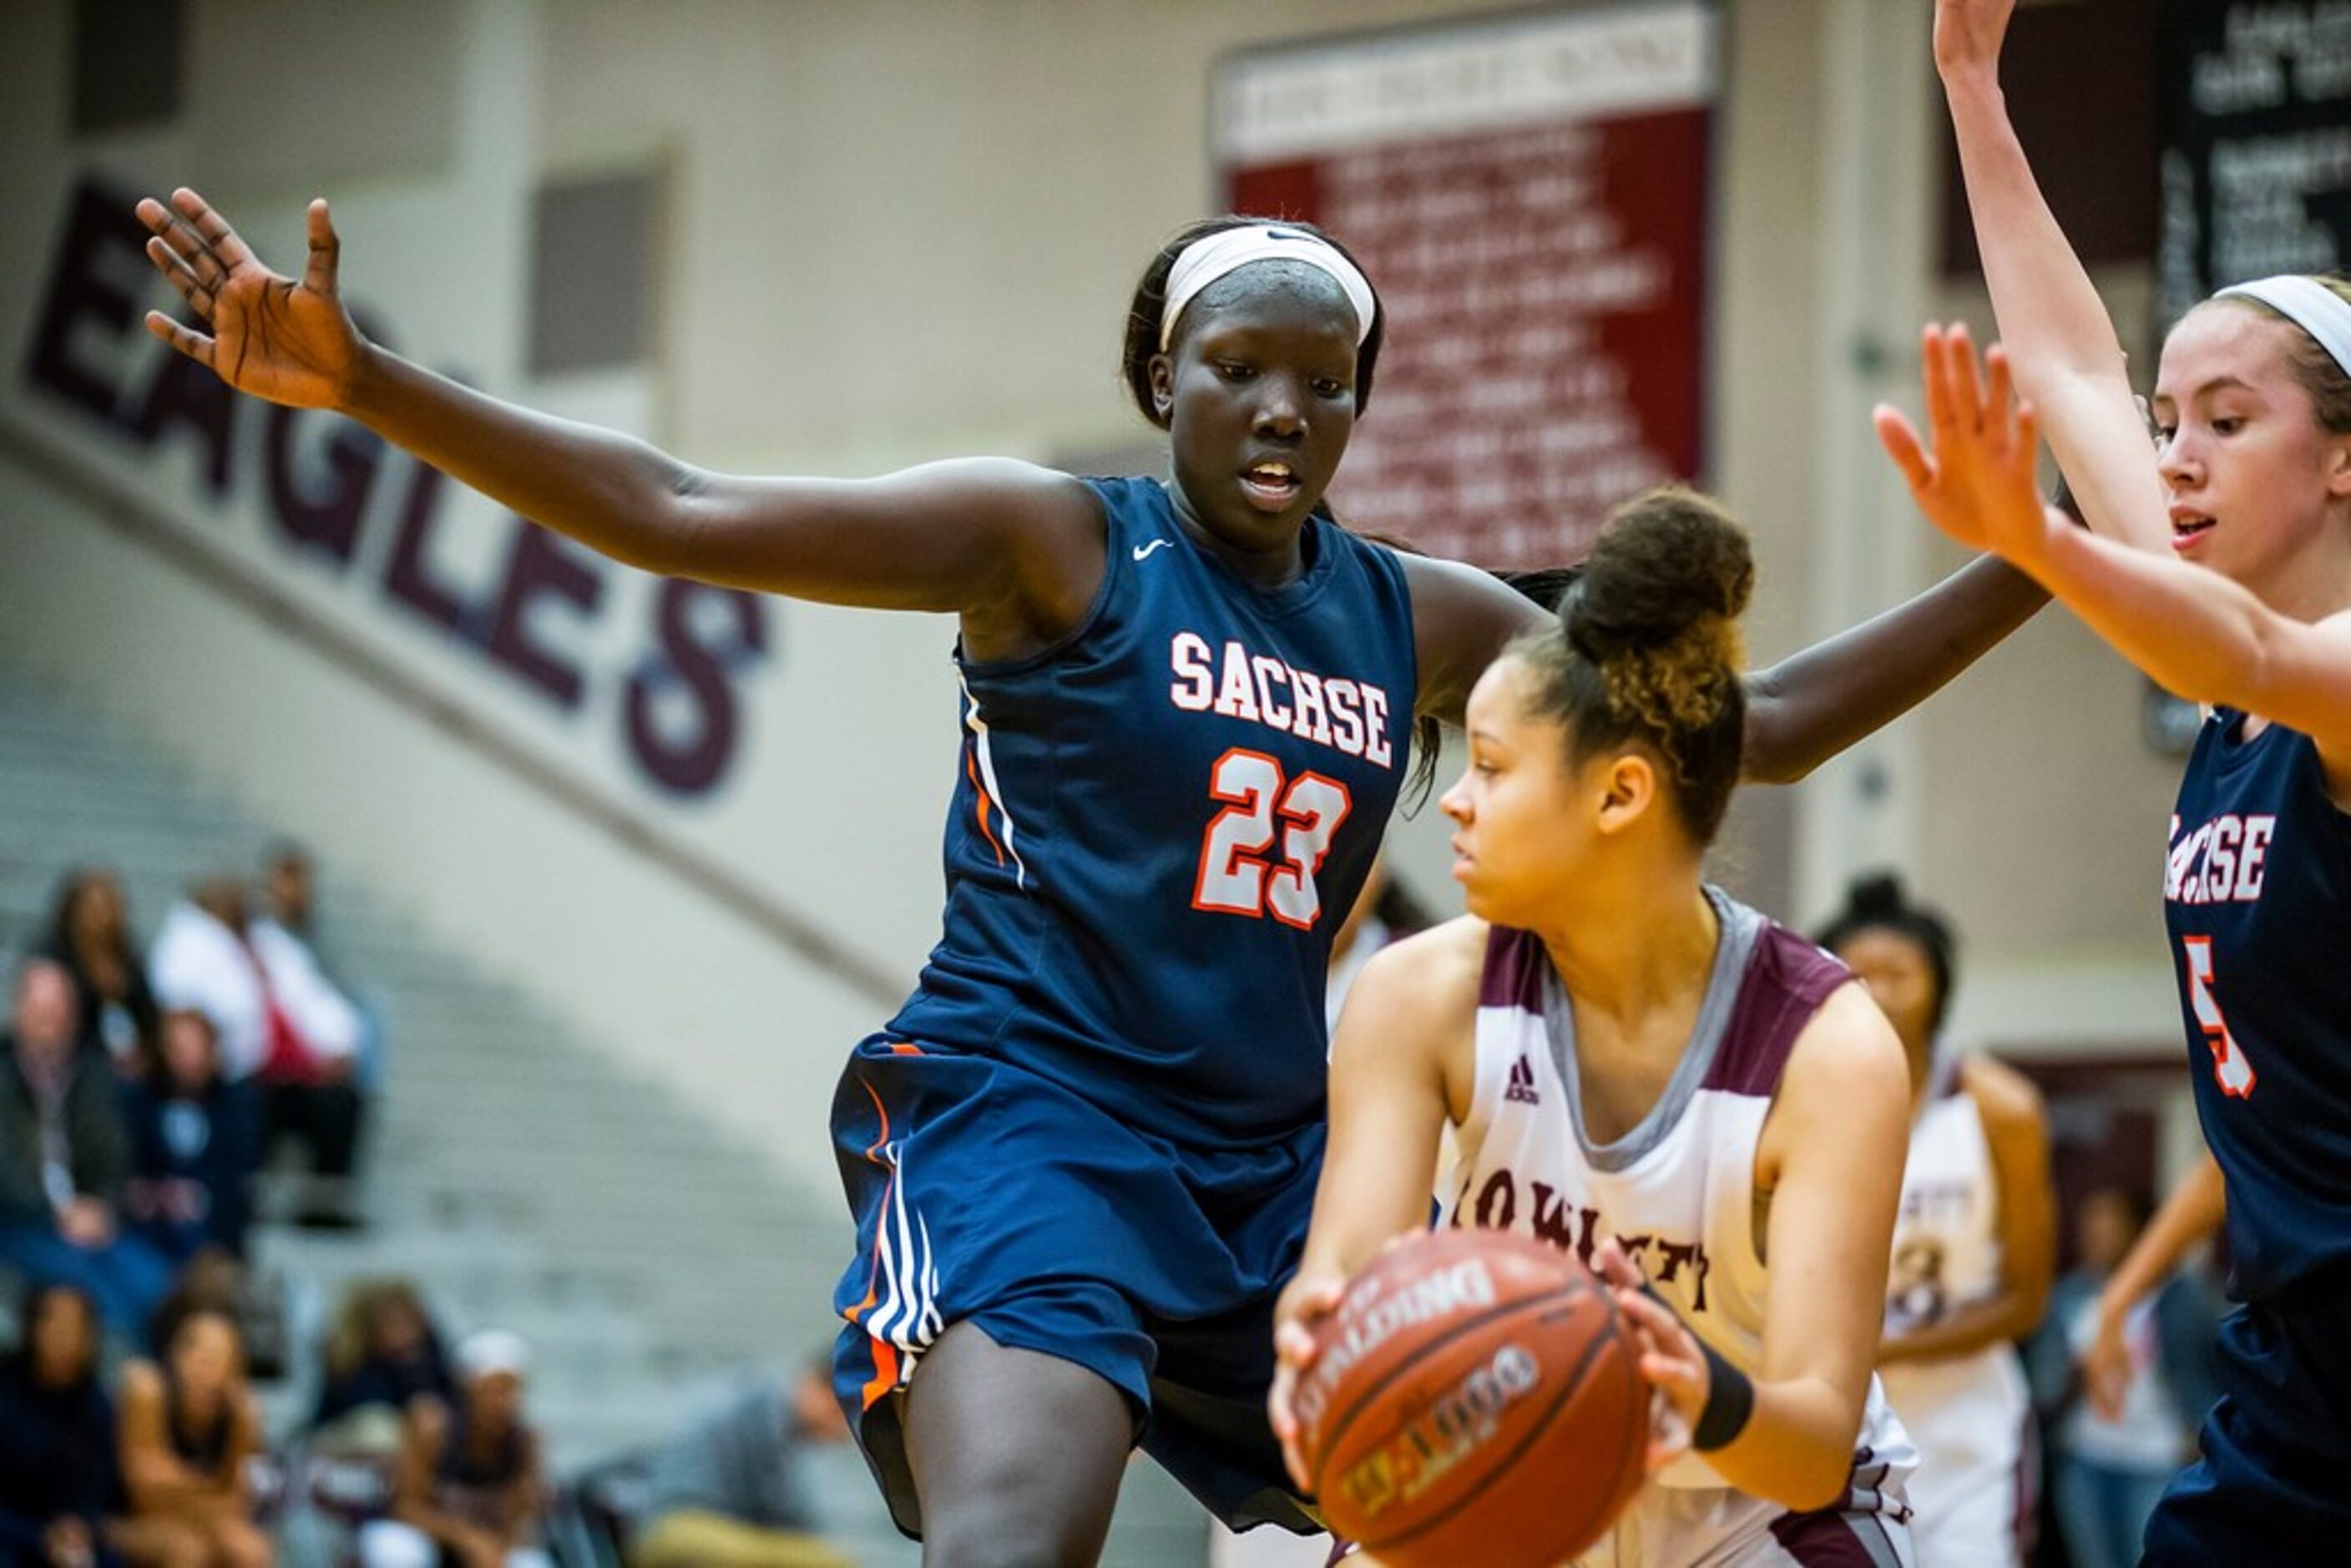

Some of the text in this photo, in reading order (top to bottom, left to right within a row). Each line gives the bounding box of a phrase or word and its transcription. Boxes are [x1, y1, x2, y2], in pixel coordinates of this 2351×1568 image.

[29, 174, 771, 798] EAGLES
[1170, 631, 1392, 770] SACHSE
[1191, 746, 1352, 932] 23
[2182, 935, 2257, 1100] 5
[1451, 1167, 1709, 1313] OWLTT
